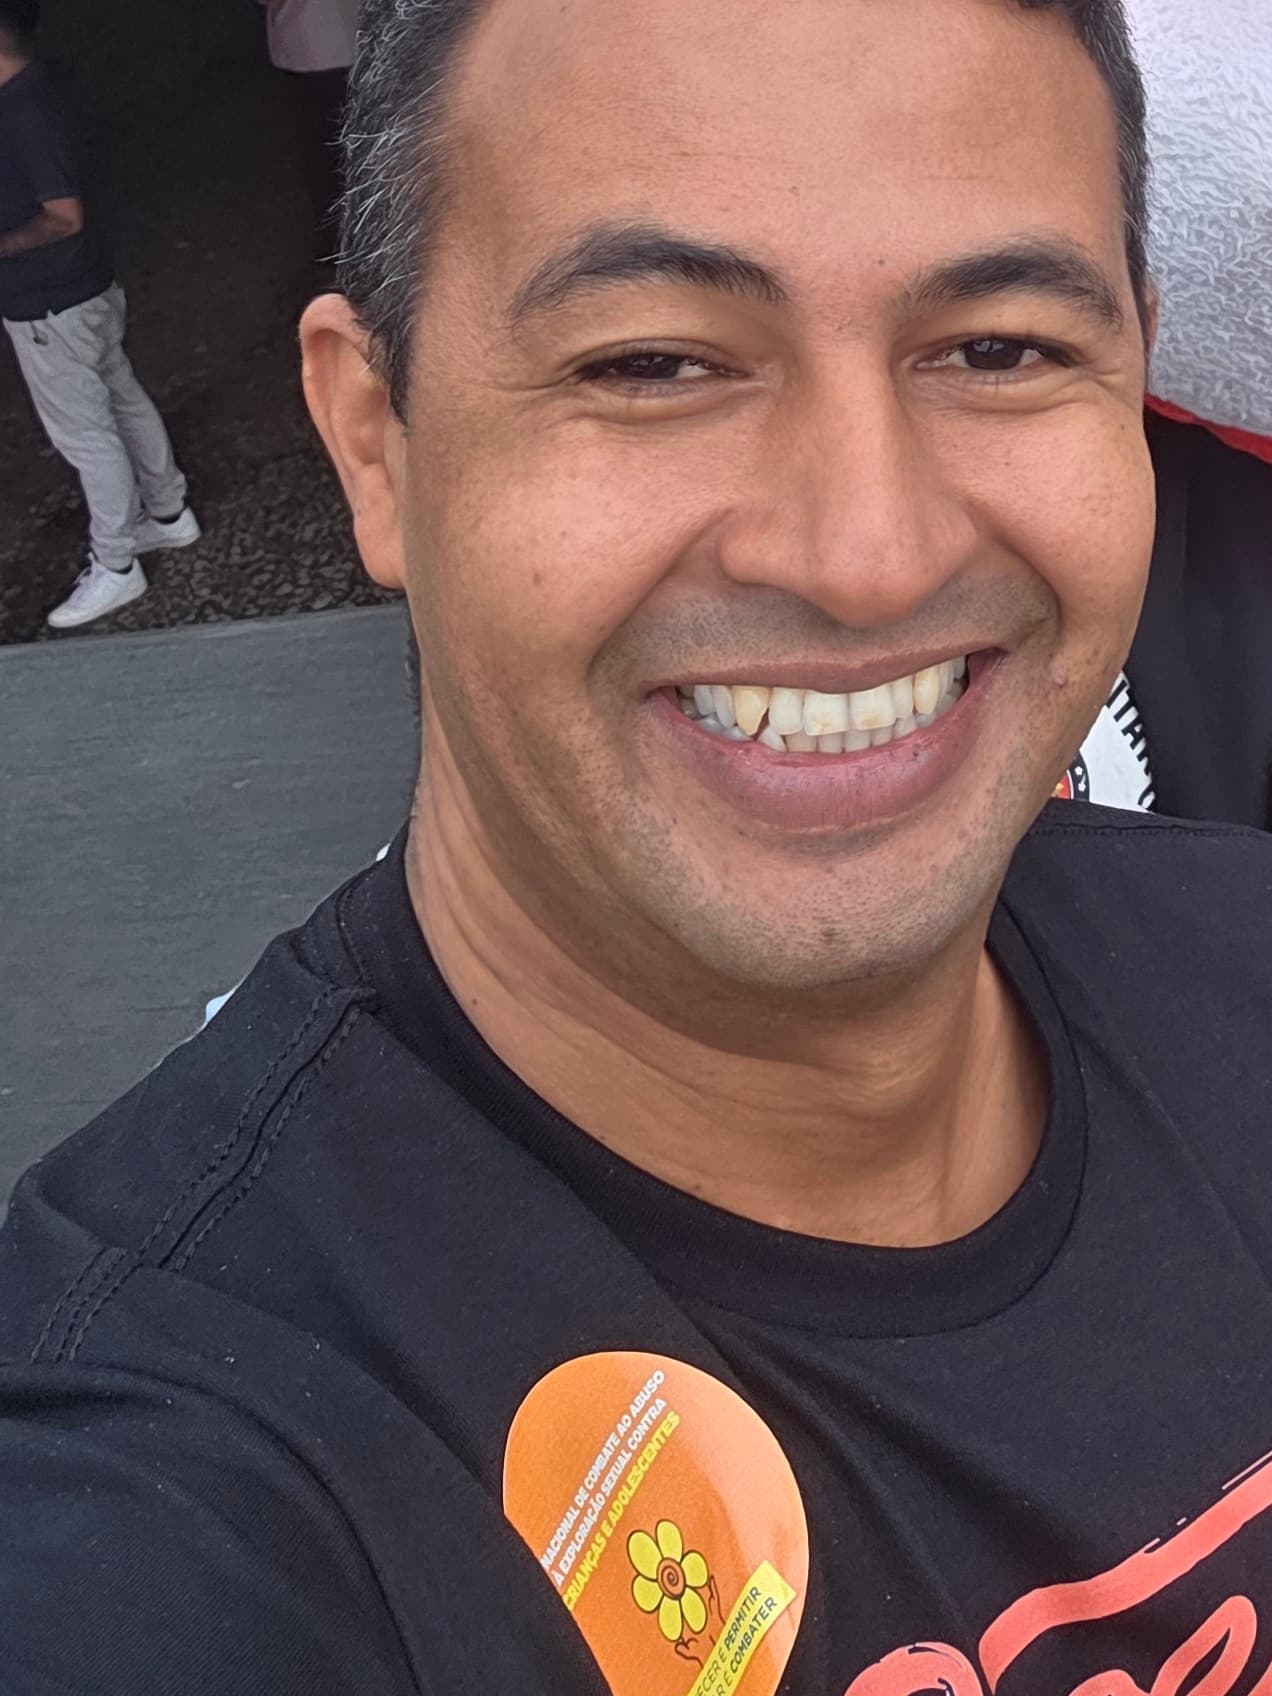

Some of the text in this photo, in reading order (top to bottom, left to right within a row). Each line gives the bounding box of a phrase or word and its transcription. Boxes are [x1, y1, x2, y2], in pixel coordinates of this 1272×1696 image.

[540, 1370, 665, 1569] NACIONAL DE COMBATE AO ABUSO
[559, 1493, 606, 1574] EXPLORAÇÃO
[601, 1449, 632, 1496] SEXUAL
[628, 1398, 667, 1451] CONTRA
[562, 1410, 681, 1610] CRIANÇAS E ADOLESCENTES
[723, 1586, 762, 1652] PERMITIR
[730, 1596, 778, 1674] COMBATER
